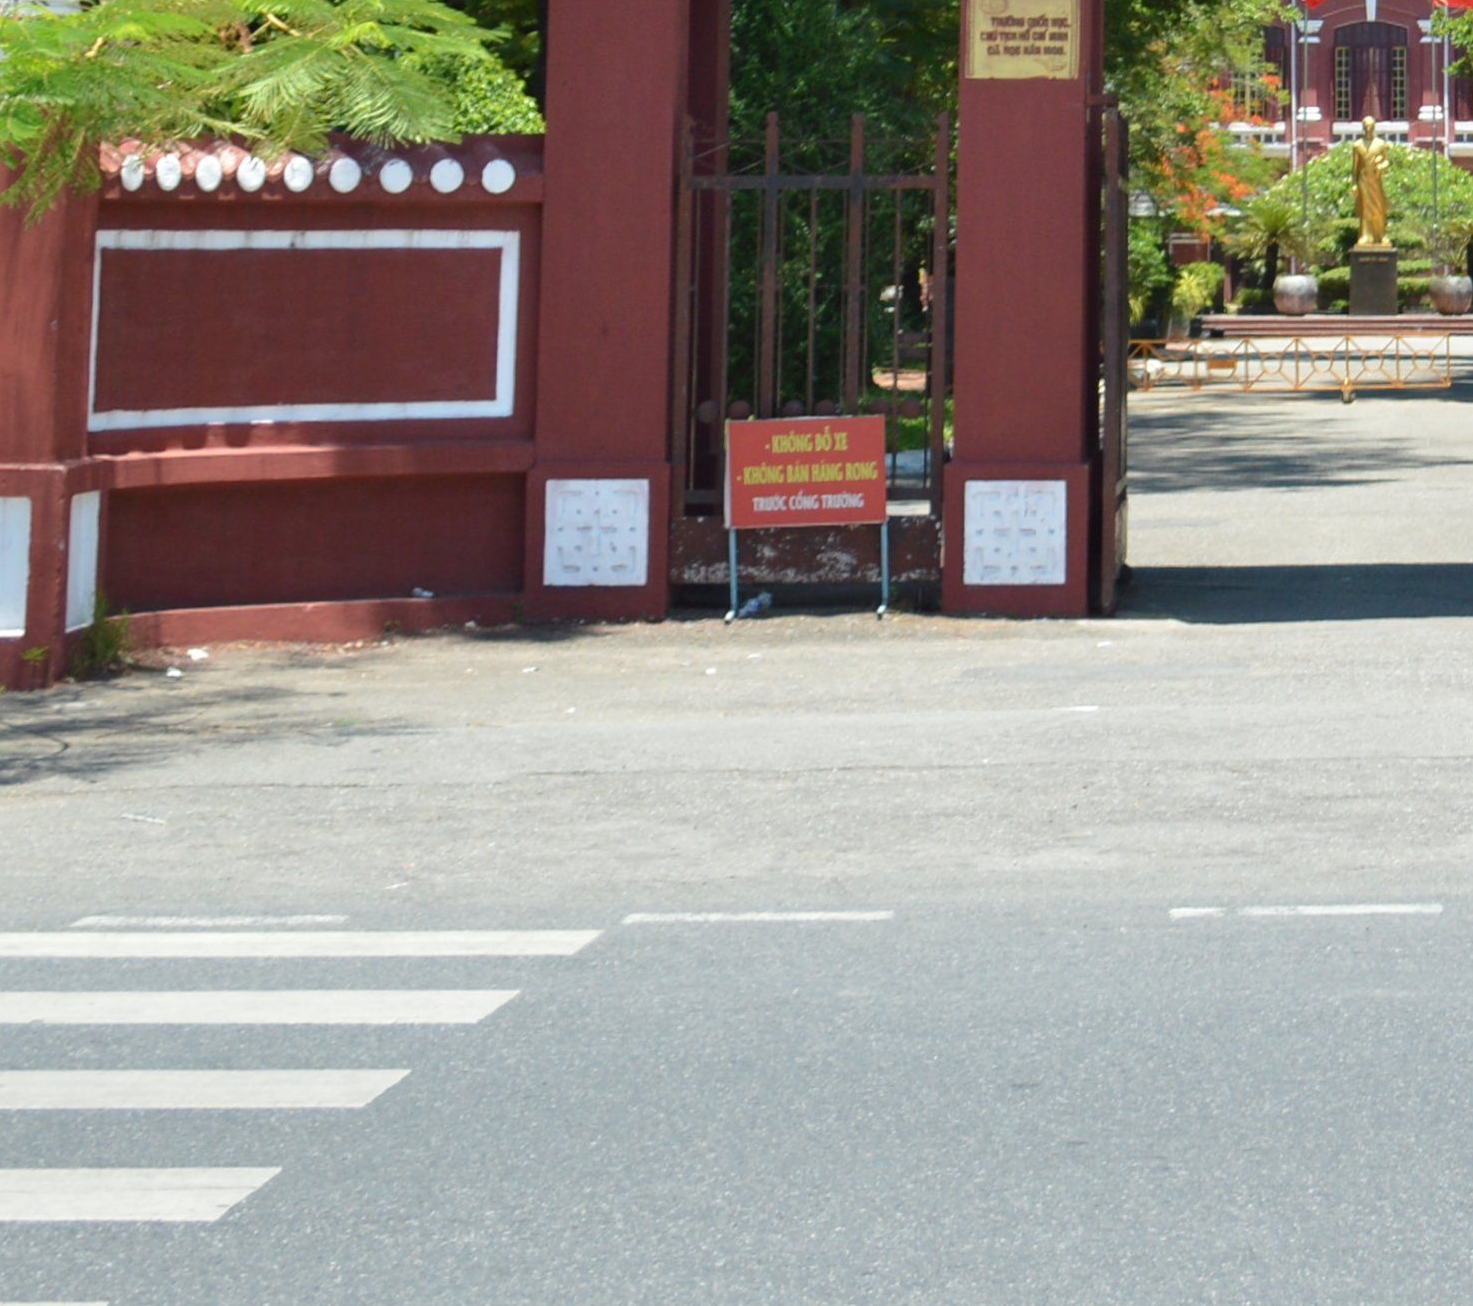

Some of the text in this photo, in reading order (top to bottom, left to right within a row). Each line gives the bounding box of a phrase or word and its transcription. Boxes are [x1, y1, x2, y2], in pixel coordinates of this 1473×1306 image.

[772, 431, 812, 454] KHÔNG
[834, 432, 848, 451] XE
[743, 461, 784, 485] KHÔNG
[786, 460, 809, 484] BÁN
[845, 461, 879, 481] RONG
[820, 491, 865, 509] TRƯỜNG
